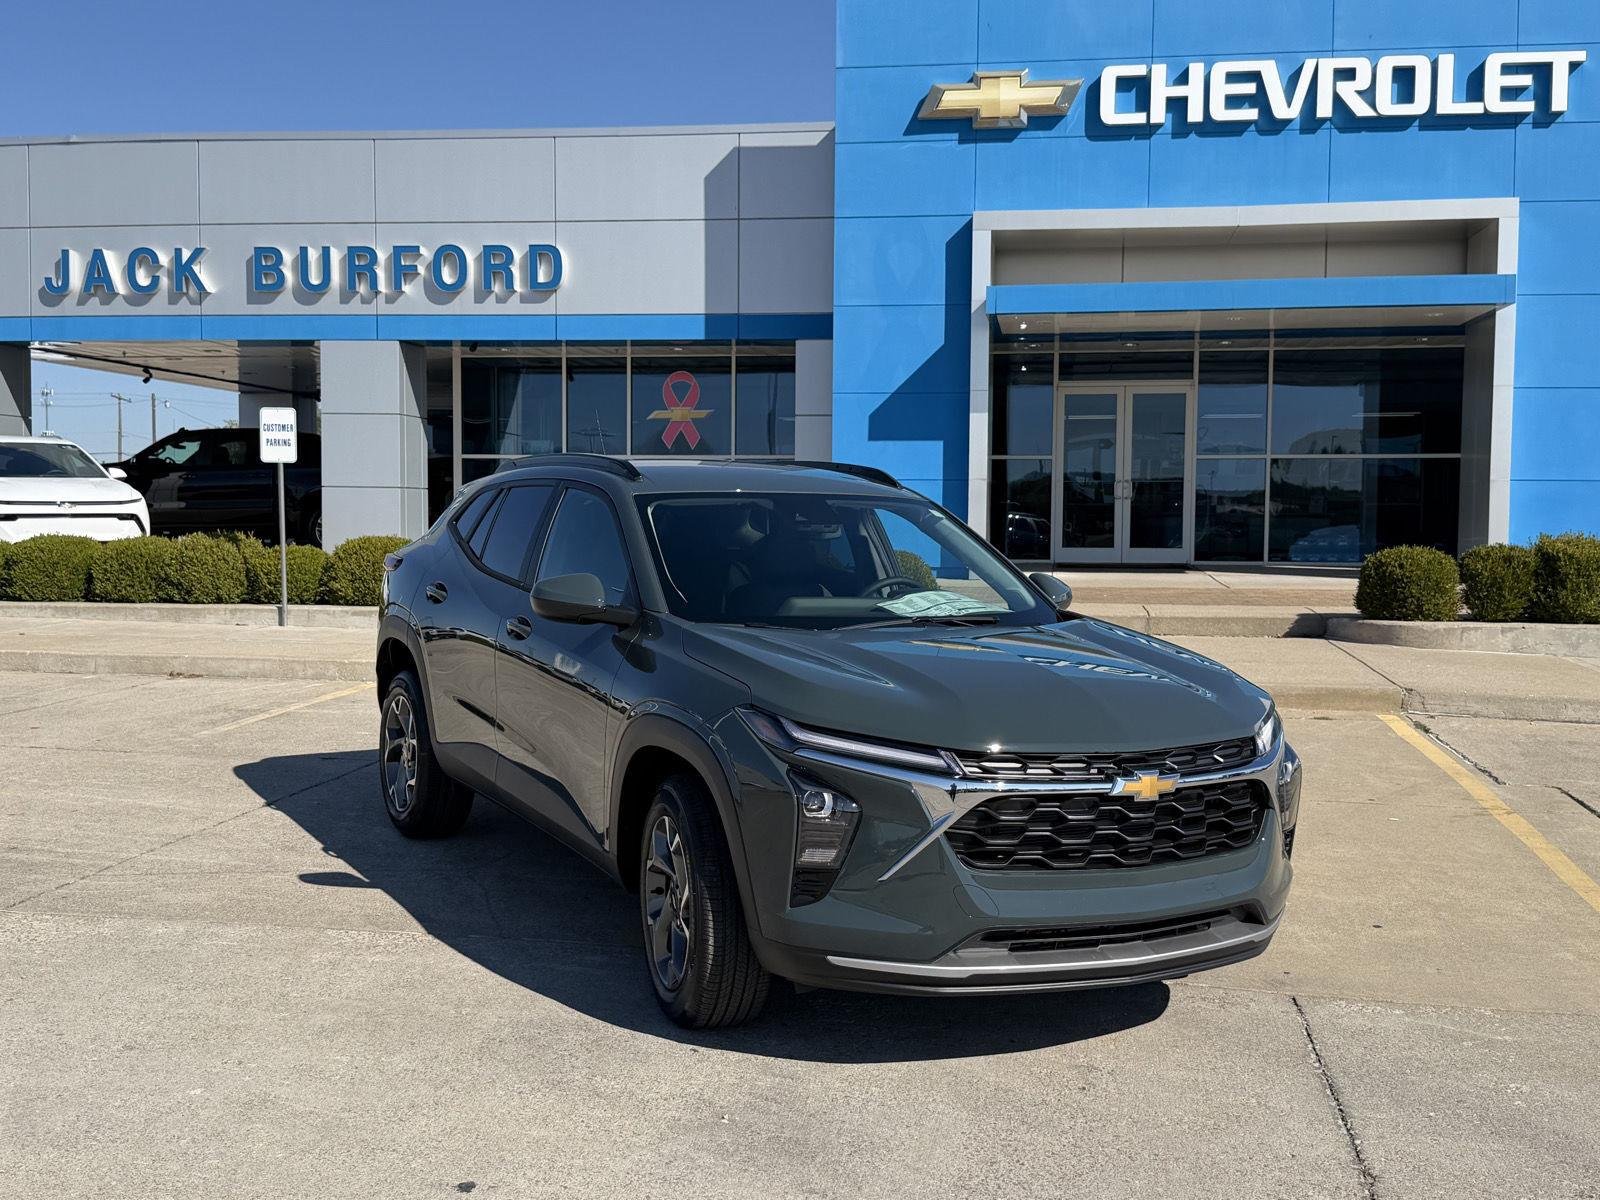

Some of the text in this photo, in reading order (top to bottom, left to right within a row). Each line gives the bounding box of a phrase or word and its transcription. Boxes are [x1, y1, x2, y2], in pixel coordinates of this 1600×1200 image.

[1100, 50, 1588, 126] CHEVROLET
[44, 244, 563, 295] JACK BURFORD
[262, 423, 294, 432] CUSTOMER
[266, 438, 292, 447] PARKING
